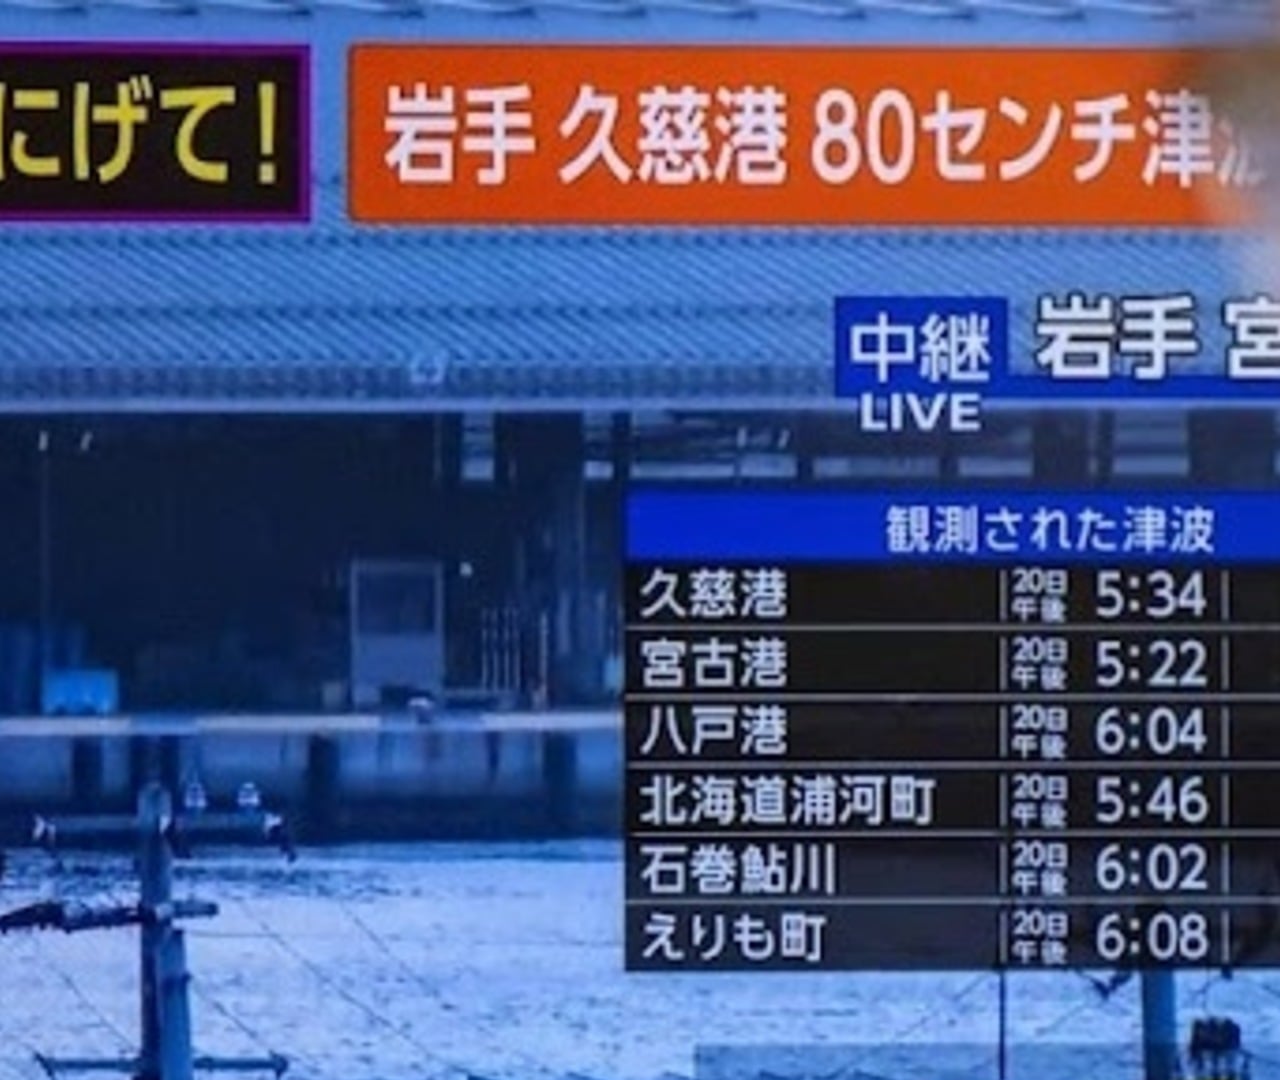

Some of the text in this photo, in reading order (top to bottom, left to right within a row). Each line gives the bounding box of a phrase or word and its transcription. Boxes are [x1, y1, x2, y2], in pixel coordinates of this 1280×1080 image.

[385, 83, 535, 184] 岩手
[560, 85, 786, 183] 久慈港
[851, 313, 990, 382] 中継
[1036, 296, 1197, 379] 岩手
[860, 394, 981, 431] LIVE
[887, 506, 1213, 553] 観測された津波
[642, 569, 786, 617] 久慈港
[1012, 568, 1068, 594] 20日
[1097, 570, 1206, 617] 5:34
[642, 638, 786, 687] 宮古港
[1012, 637, 1068, 663] 20日
[1097, 640, 1207, 686] 5:22
[641, 705, 786, 754] 八戸港
[1012, 704, 1068, 730] 20日
[1097, 707, 1206, 754] 6:04
[641, 775, 935, 825] 北海道浦河町
[1012, 773, 1068, 799] 20日
[1097, 776, 1208, 822] 5:46
[1012, 840, 1068, 866] 20日
[1097, 844, 1207, 890] 6:02
[643, 913, 826, 961] えりも町
[1012, 910, 1068, 936] 20日
[1097, 913, 1208, 960] 6:08
